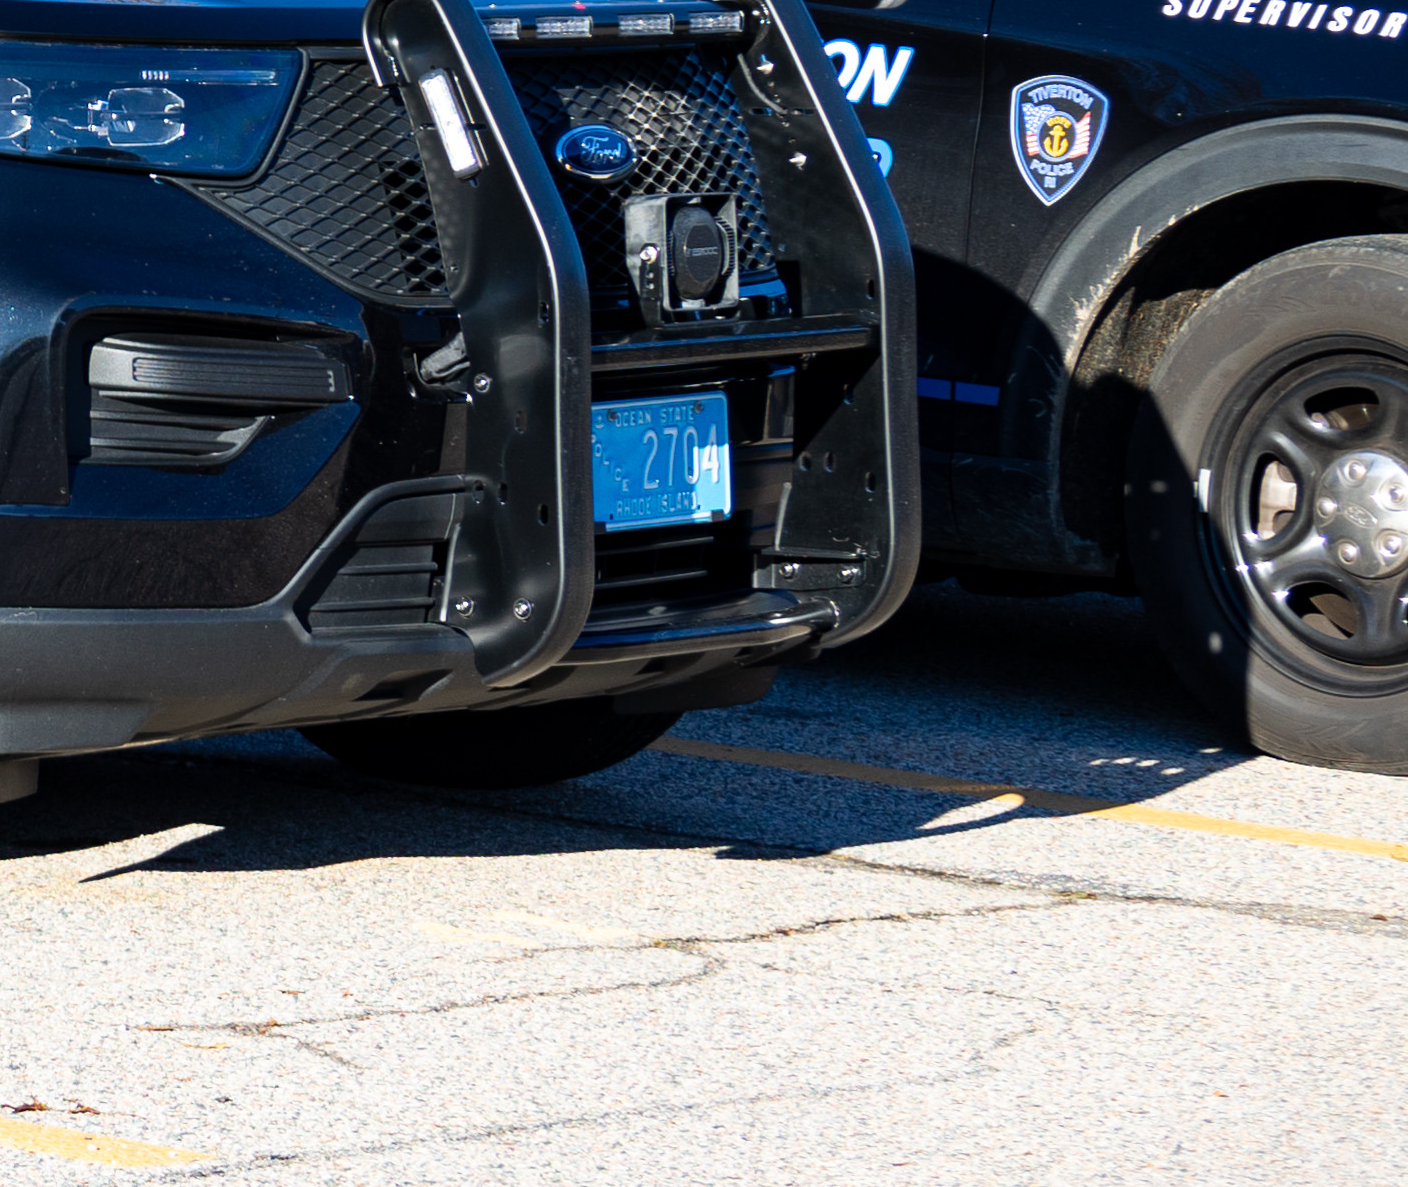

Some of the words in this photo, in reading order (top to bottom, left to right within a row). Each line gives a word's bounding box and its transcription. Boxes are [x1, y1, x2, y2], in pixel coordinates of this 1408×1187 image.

[1028, 85, 1093, 109] TIVERTON
[580, 135, 623, 165] Ford
[1029, 159, 1074, 177] POLICE
[615, 411, 652, 428] OCEAN
[660, 404, 695, 424] STATE
[642, 423, 721, 491] 2704
[616, 498, 651, 518] RHODE
[657, 491, 698, 514] ISLAND
